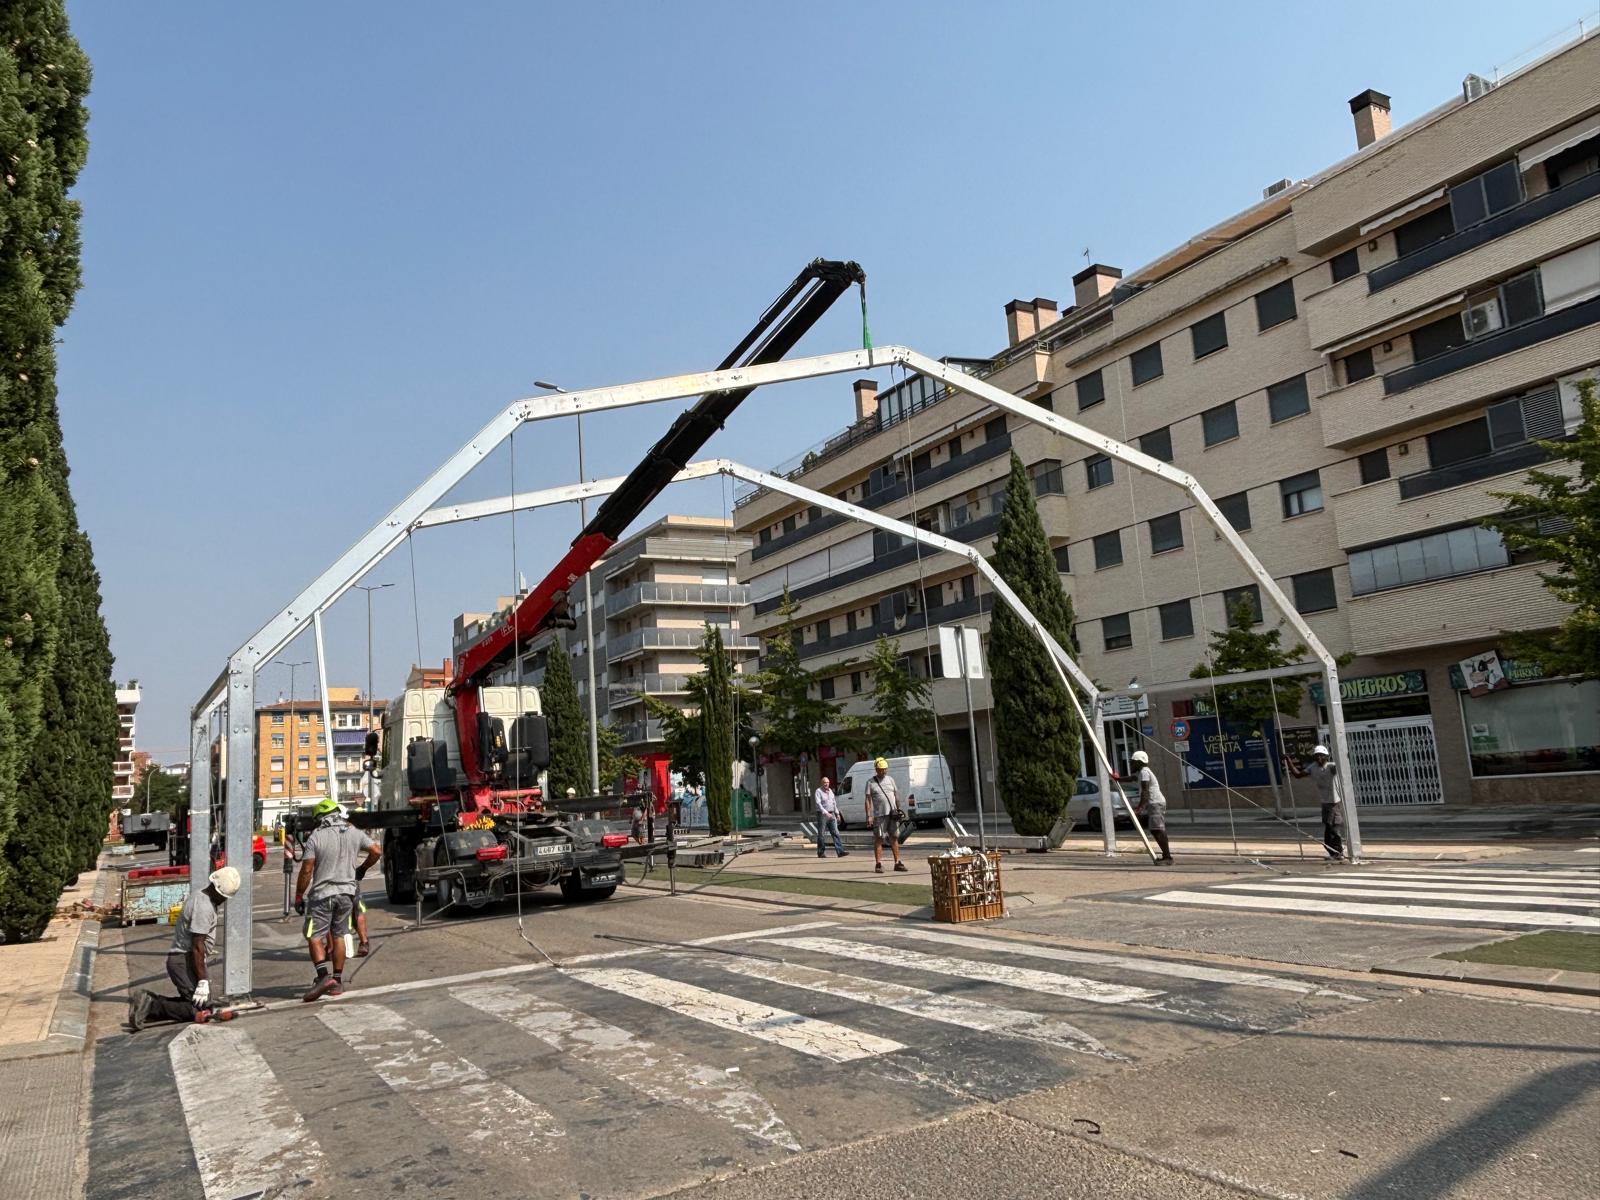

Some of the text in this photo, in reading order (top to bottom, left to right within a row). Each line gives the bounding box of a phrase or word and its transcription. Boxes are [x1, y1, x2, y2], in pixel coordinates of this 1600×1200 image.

[1339, 674, 1407, 699] ONEGROS
[1203, 732, 1229, 743] Local
[1205, 740, 1242, 755] VENTA
